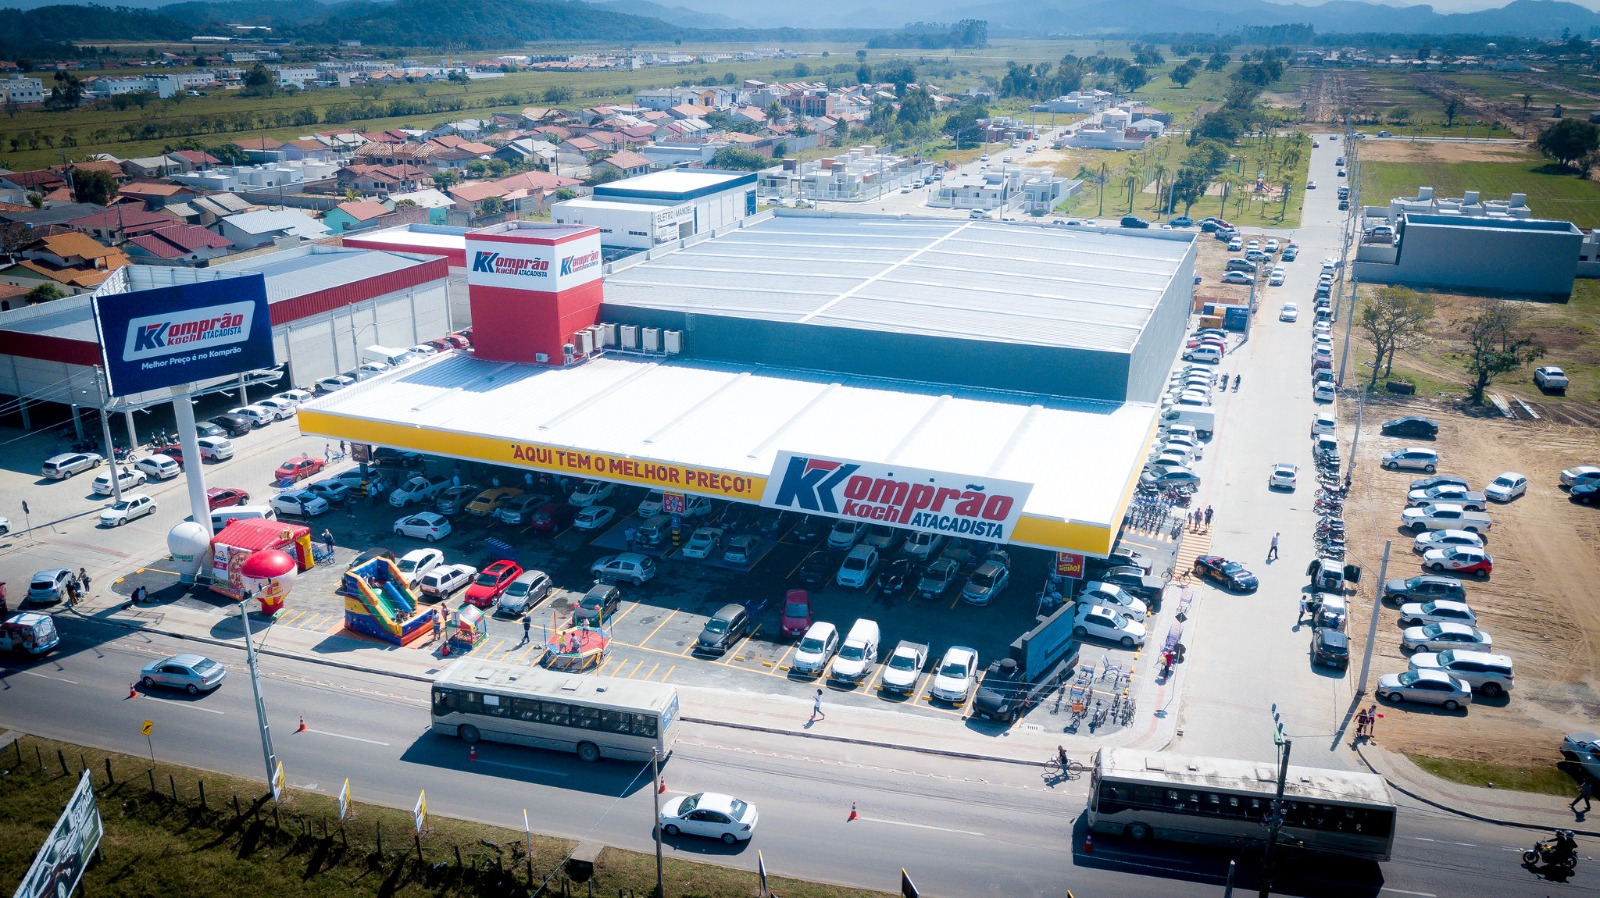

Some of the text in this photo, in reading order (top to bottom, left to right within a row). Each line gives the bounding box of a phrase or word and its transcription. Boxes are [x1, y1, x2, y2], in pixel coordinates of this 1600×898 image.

[167, 325, 242, 347] koch ATACADISTA
[141, 346, 242, 371] Melhor Preço é no Komprão
[513, 445, 752, 493] AQUI TEM O MELHOR PREÇO!
[841, 499, 1004, 539] koch ATACADISTA
